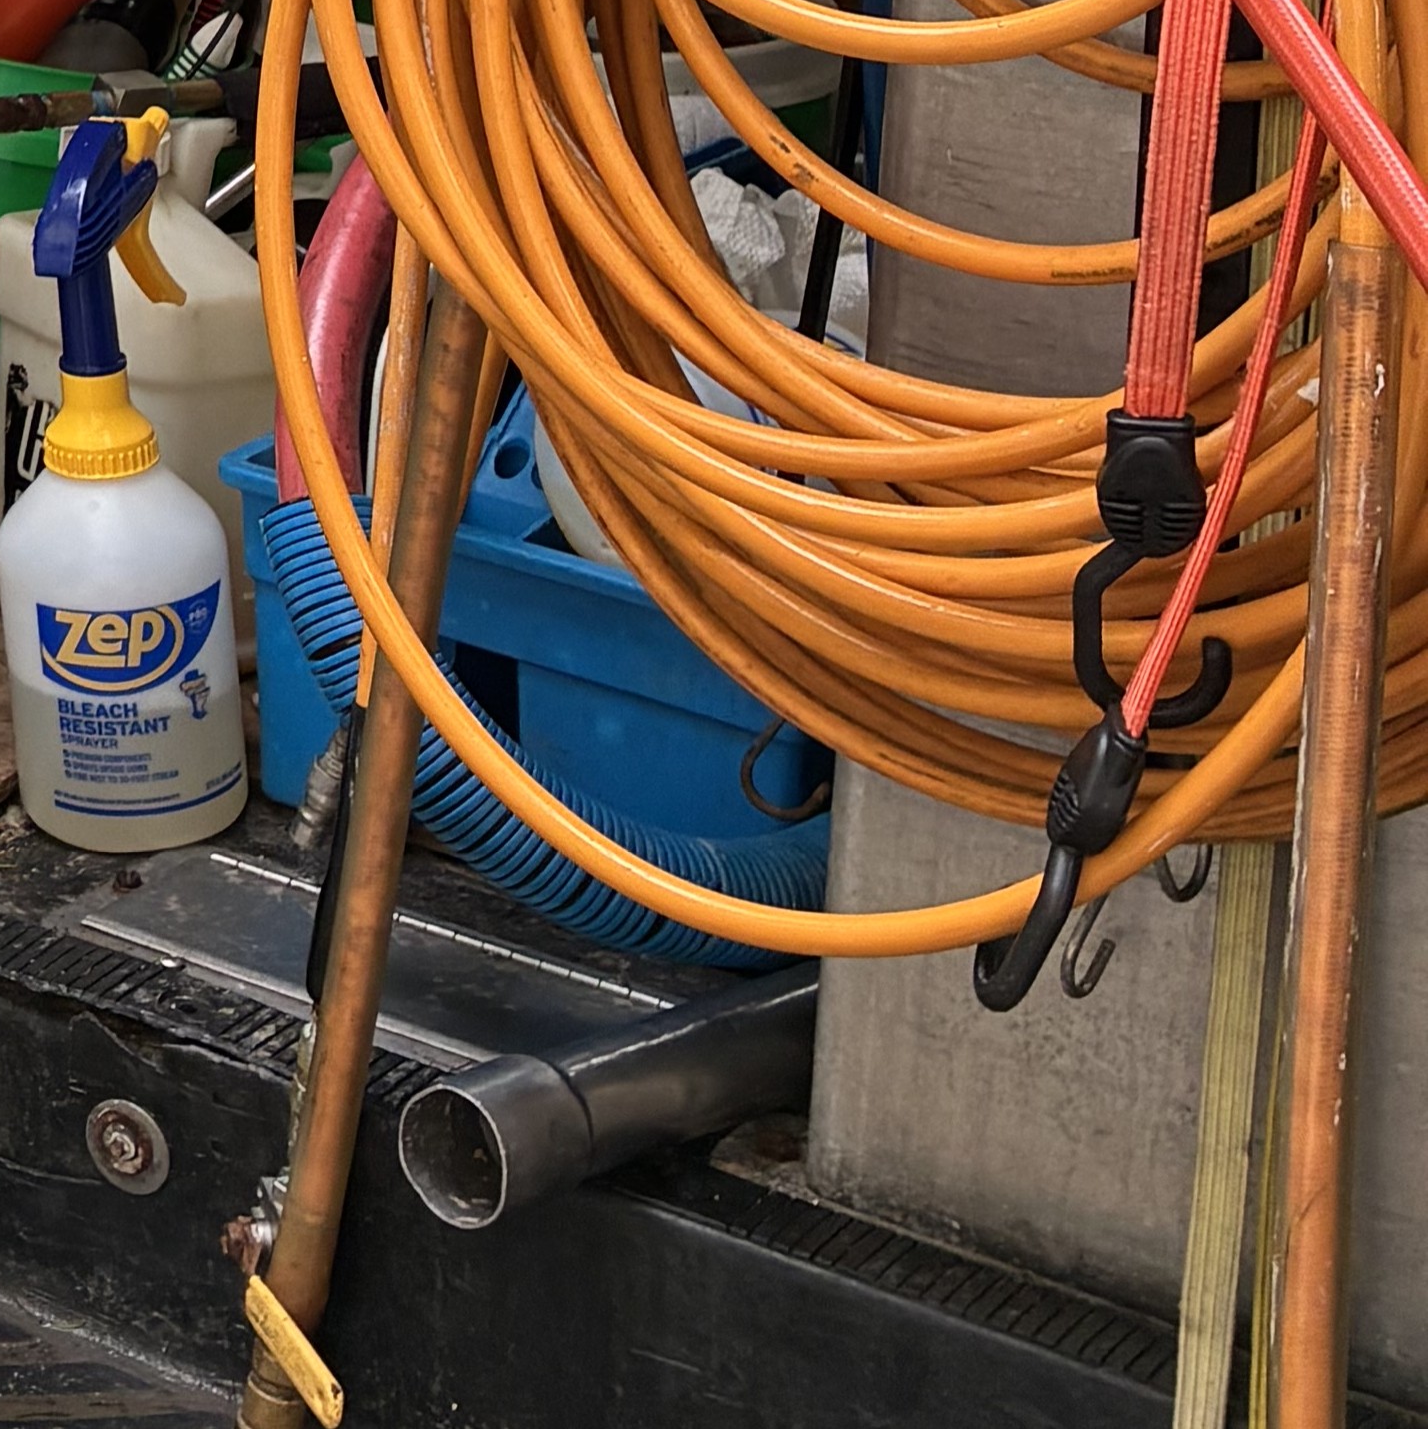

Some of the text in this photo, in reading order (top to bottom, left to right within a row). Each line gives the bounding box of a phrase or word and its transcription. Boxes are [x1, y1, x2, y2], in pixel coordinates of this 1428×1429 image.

[55, 609, 166, 668] Zep
[57, 697, 139, 719] BLEACH
[58, 715, 171, 737] RESISTANT
[60, 733, 119, 750] SPRAYER
